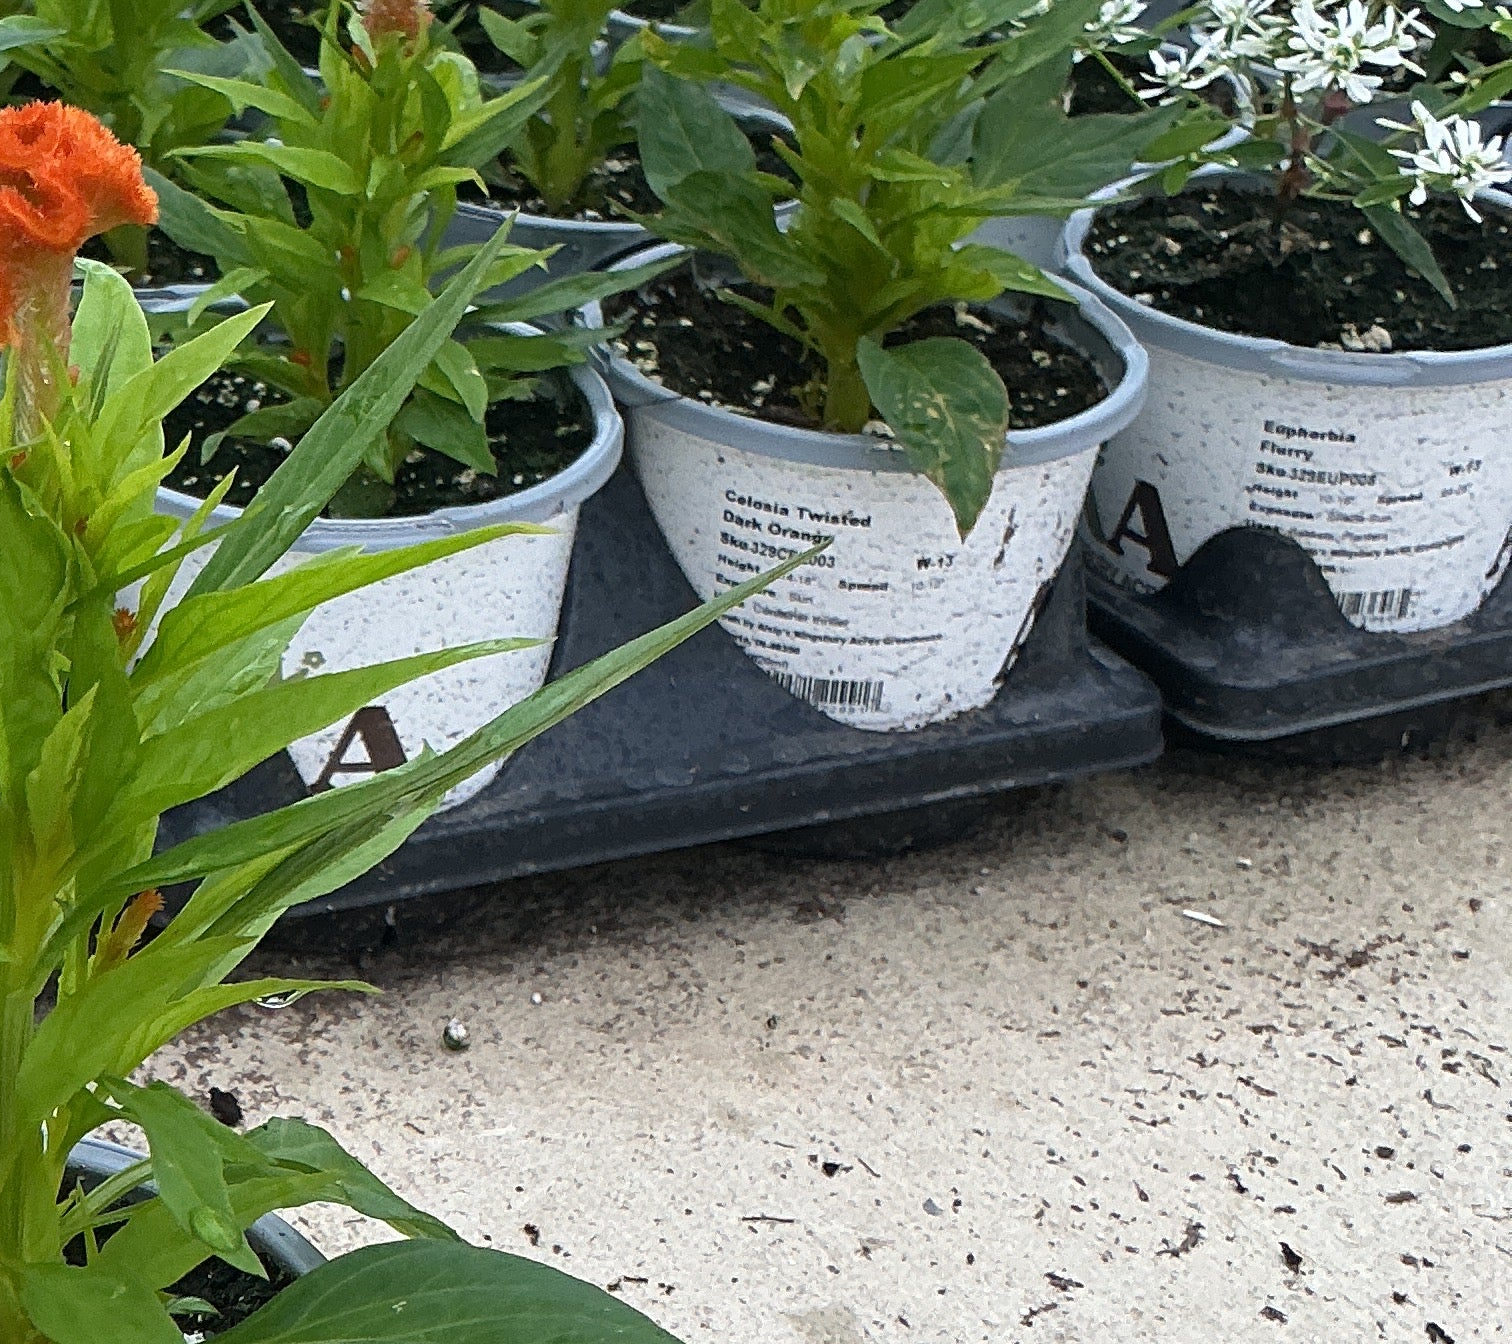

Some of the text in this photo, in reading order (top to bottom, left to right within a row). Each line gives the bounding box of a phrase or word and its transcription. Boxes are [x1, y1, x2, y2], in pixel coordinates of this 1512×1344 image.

[723, 509, 834, 546] Dark Orang
[724, 488, 873, 529] Celosia Twisted
